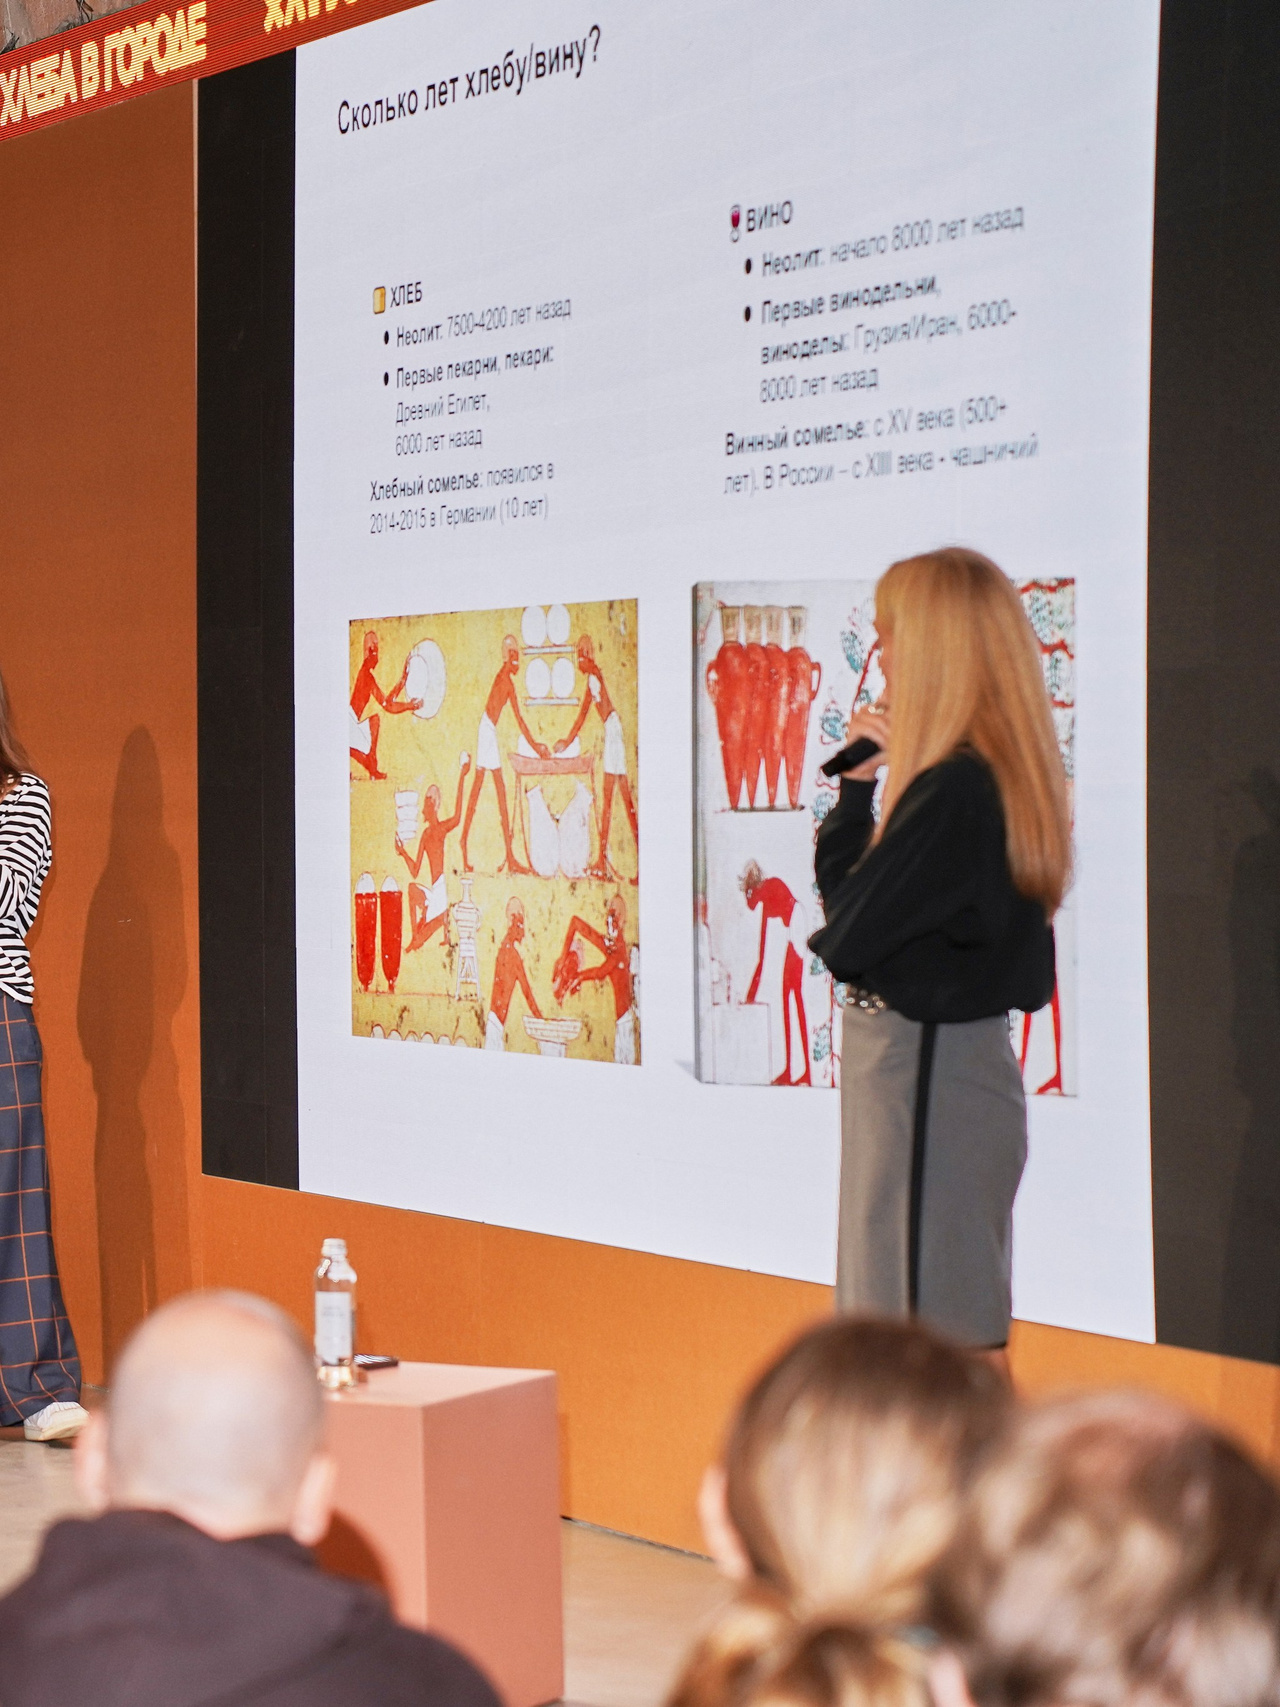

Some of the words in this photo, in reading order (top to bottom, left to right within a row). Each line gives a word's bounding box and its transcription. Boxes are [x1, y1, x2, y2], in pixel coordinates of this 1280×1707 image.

[0, 49, 77, 126] ХЛЕБА
[81, 40, 100, 100] В
[104, 1, 207, 92] ГОРОДЕ
[338, 89, 419, 135] Сколько
[425, 77, 459, 112] лет
[465, 24, 601, 95] хлебу/вину?
[746, 200, 793, 232] ВИНО
[830, 235, 888, 264] начало
[892, 219, 933, 251] 8000
[936, 218, 966, 243] лет
[972, 206, 1024, 235] назад
[390, 281, 423, 308] ХЛЕБ
[761, 296, 824, 328] Первые
[447, 306, 507, 338] 7500-4200
[510, 306, 531, 327] лет
[536, 298, 572, 321] назад
[396, 366, 443, 391] Первые
[447, 356, 501, 381] пекарни,
[760, 375, 797, 403] 8000
[800, 376, 827, 397] лет
[831, 368, 879, 393] назад
[395, 396, 444, 427] Древний
[448, 393, 490, 415] Египет,
[395, 433, 422, 456] 6000
[425, 433, 445, 452] лет
[449, 429, 483, 449] назад
[725, 425, 788, 456] Винный
[917, 407, 955, 431] века
[370, 475, 424, 501] Хлебный
[428, 470, 483, 494] сомелье:
[487, 463, 543, 487] появился
[547, 462, 554, 479] в
[763, 465, 774, 489] В
[779, 463, 834, 487] России
[897, 452, 935, 474] века
[370, 507, 426, 534] 2014-2015
[430, 510, 436, 527] в
[439, 505, 496, 530] Германии
[499, 496, 519, 525] (10
[522, 493, 549, 520] лет)
